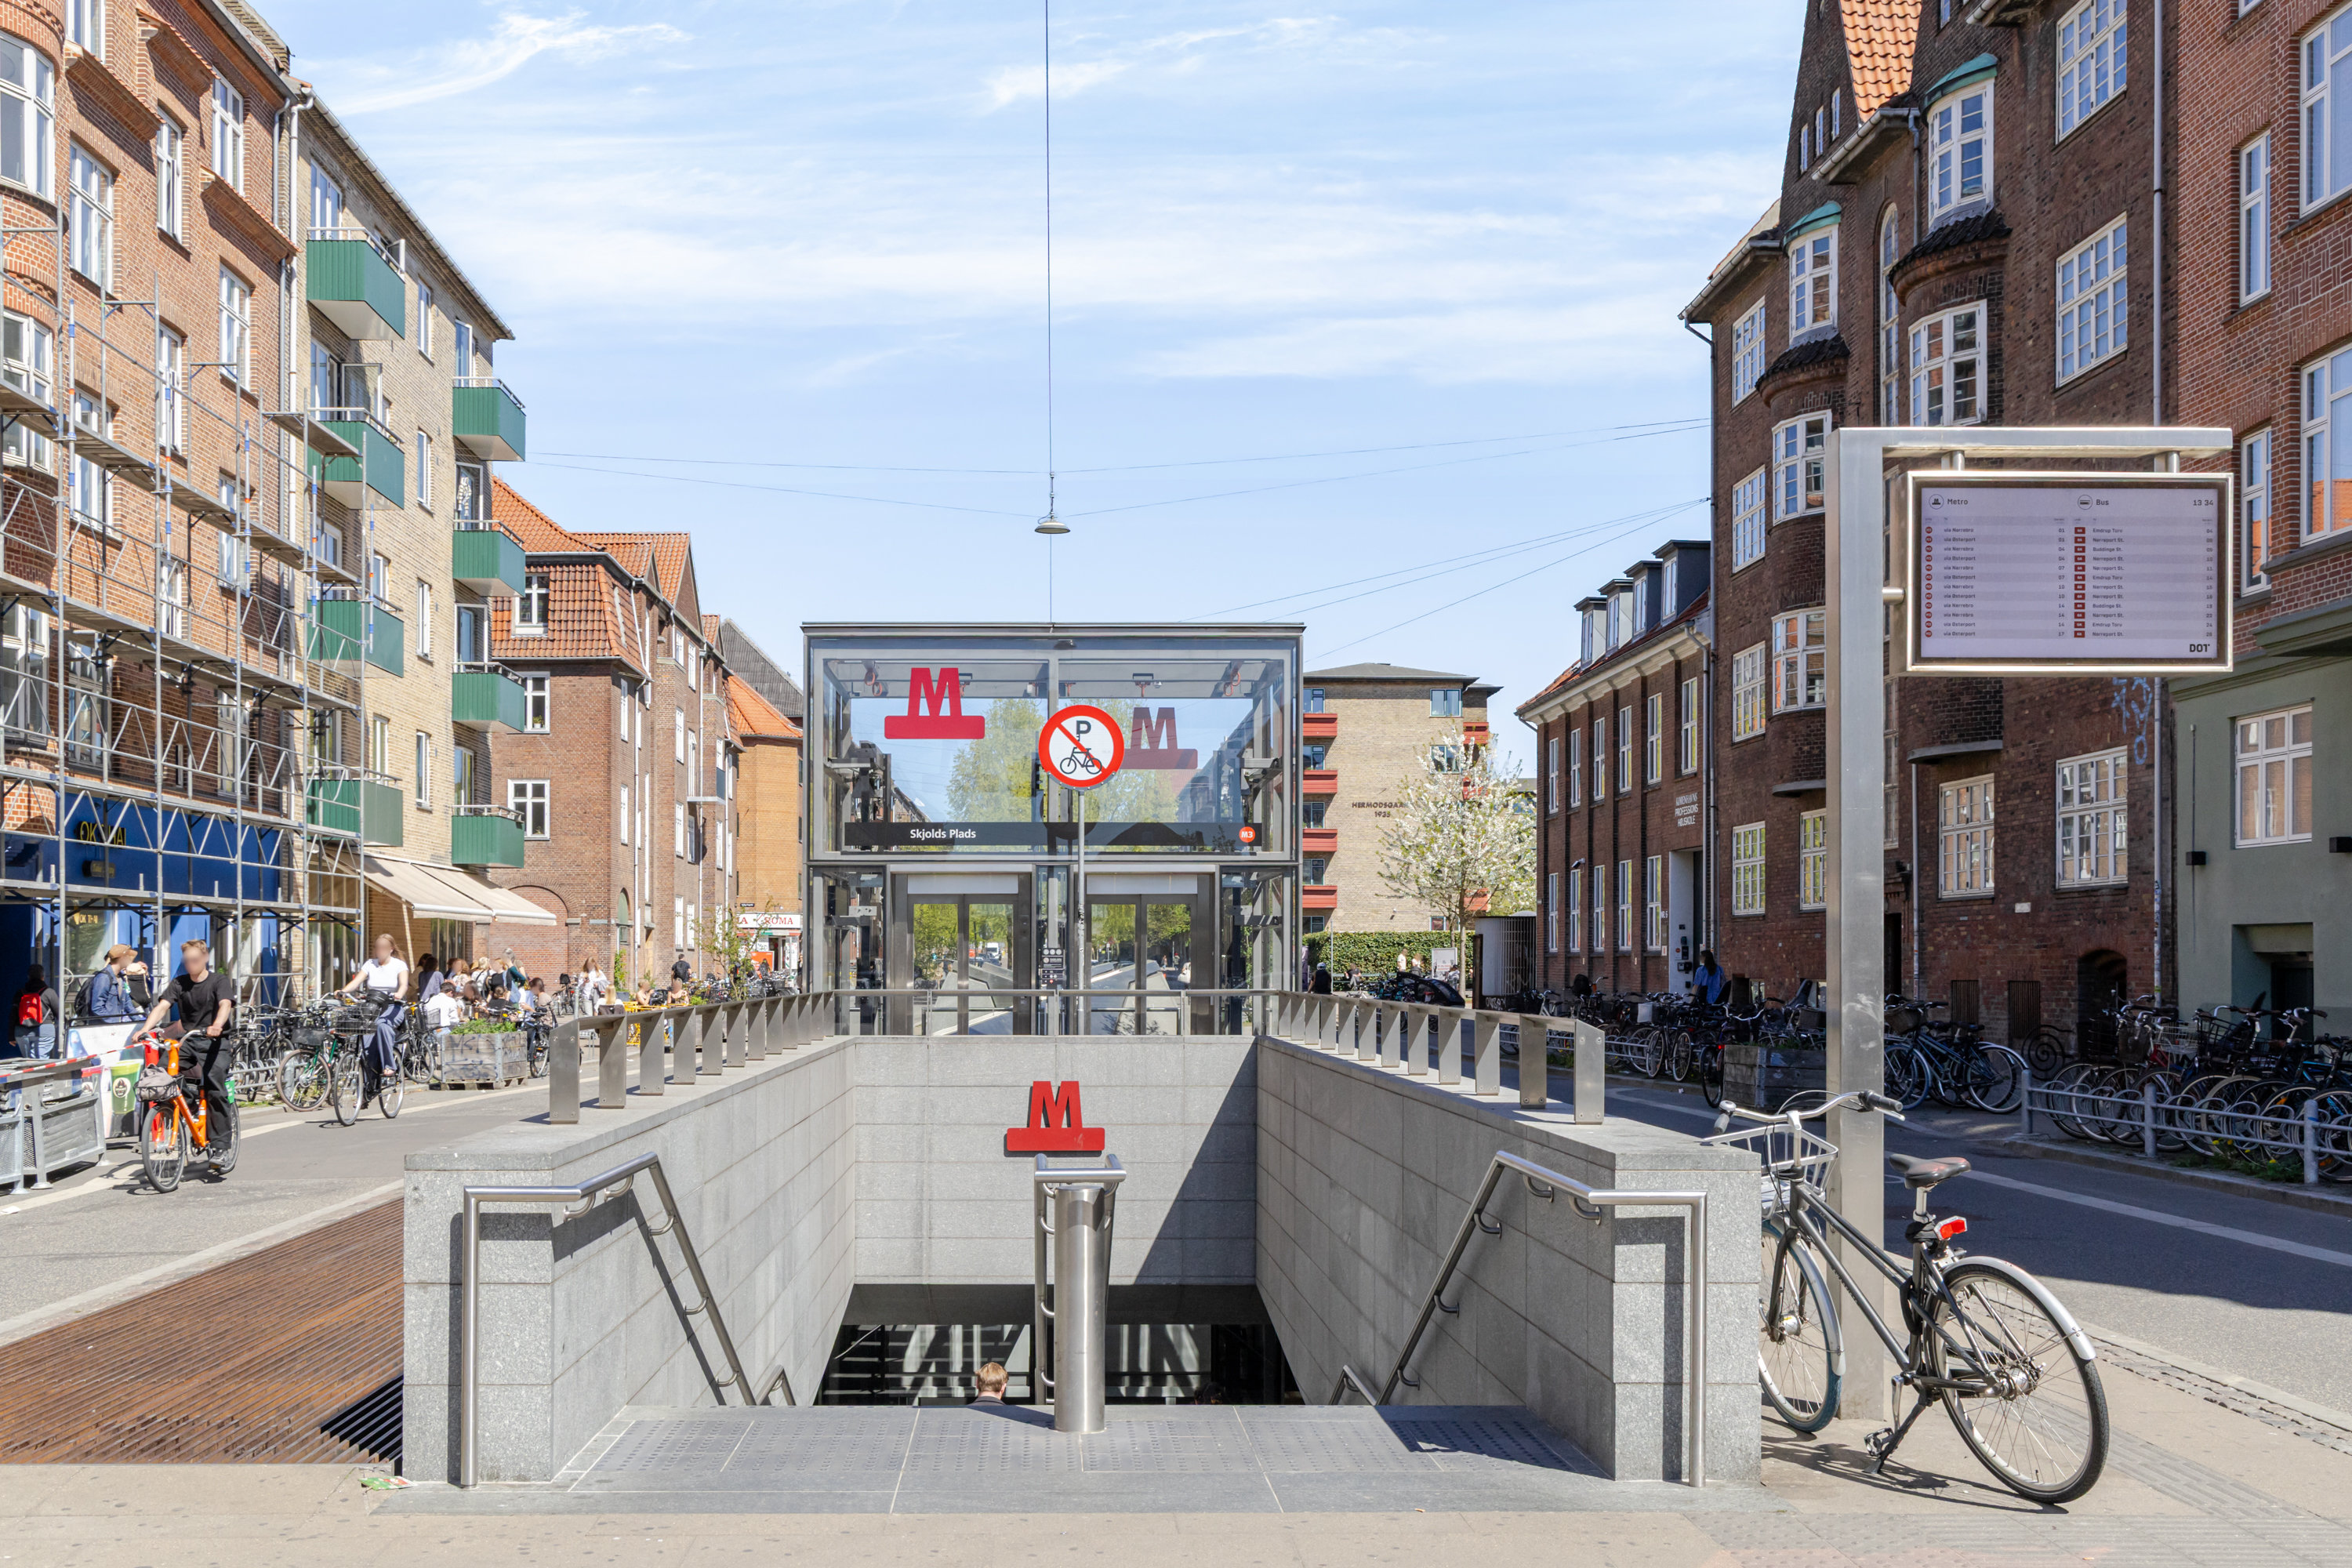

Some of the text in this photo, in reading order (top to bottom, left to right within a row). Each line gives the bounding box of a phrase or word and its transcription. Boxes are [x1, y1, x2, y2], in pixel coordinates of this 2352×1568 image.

[2189, 644, 2210, 652] DOT
[1076, 720, 1091, 742] P
[80, 821, 97, 845] OK
[910, 829, 976, 840] Skjolds Plads
